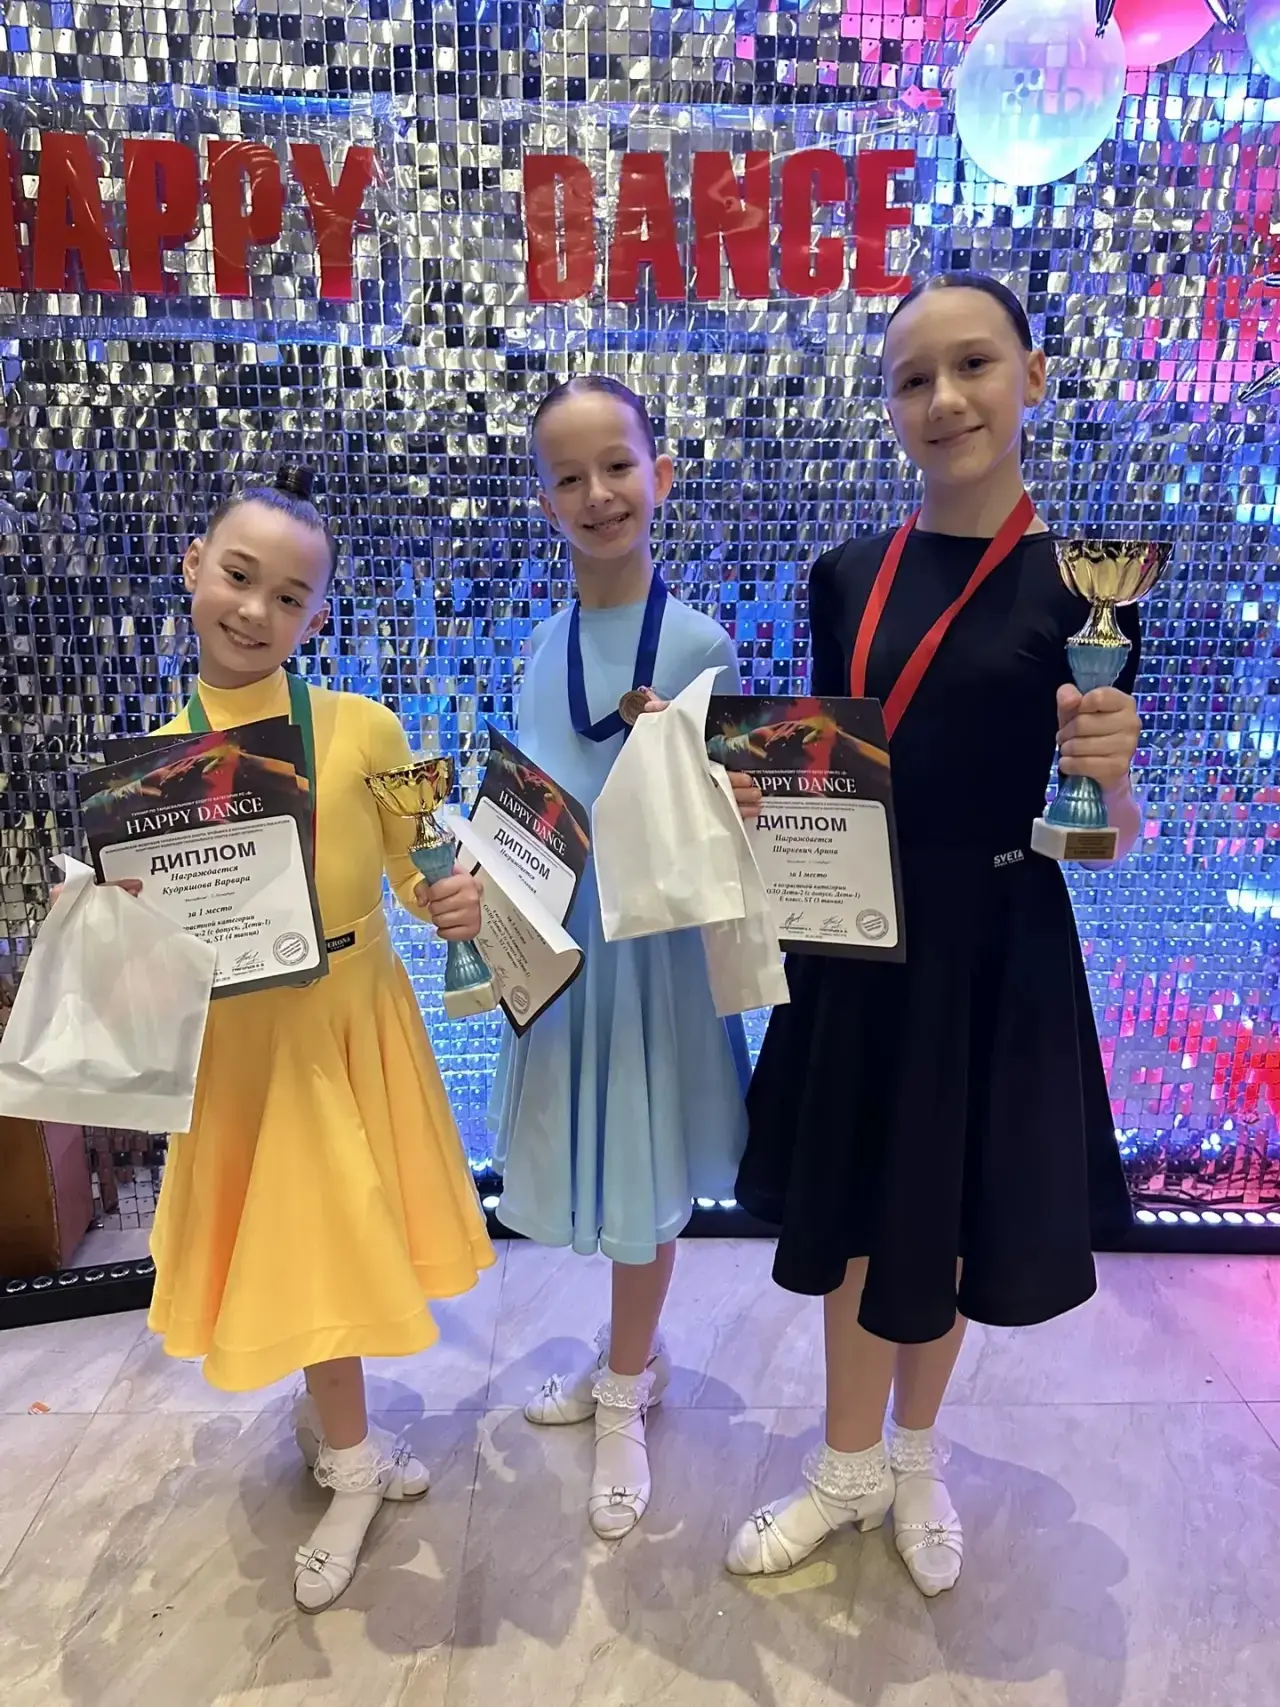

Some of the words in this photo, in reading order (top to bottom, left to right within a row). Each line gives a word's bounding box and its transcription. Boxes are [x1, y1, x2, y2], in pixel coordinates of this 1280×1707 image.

[0, 128, 375, 299] APPY
[522, 150, 915, 302] DANCE
[752, 776, 792, 791] APPY
[798, 777, 857, 793] DANCE
[126, 808, 191, 835] HAPPY
[197, 796, 264, 822] DANCE
[499, 790, 533, 824] HAPPY
[532, 818, 567, 856] DANCE
[756, 815, 847, 832] ДИПЛОМ
[775, 834, 833, 843] Награждается
[150, 841, 257, 875] ДИПЛОМ
[494, 828, 551, 880] ДИПЛОМ
[993, 849, 1024, 865] SVETA
[171, 865, 238, 881] Награждается
[162, 882, 212, 895] Кудряшова
[214, 876, 251, 887] Варвара
[205, 905, 233, 915] место
